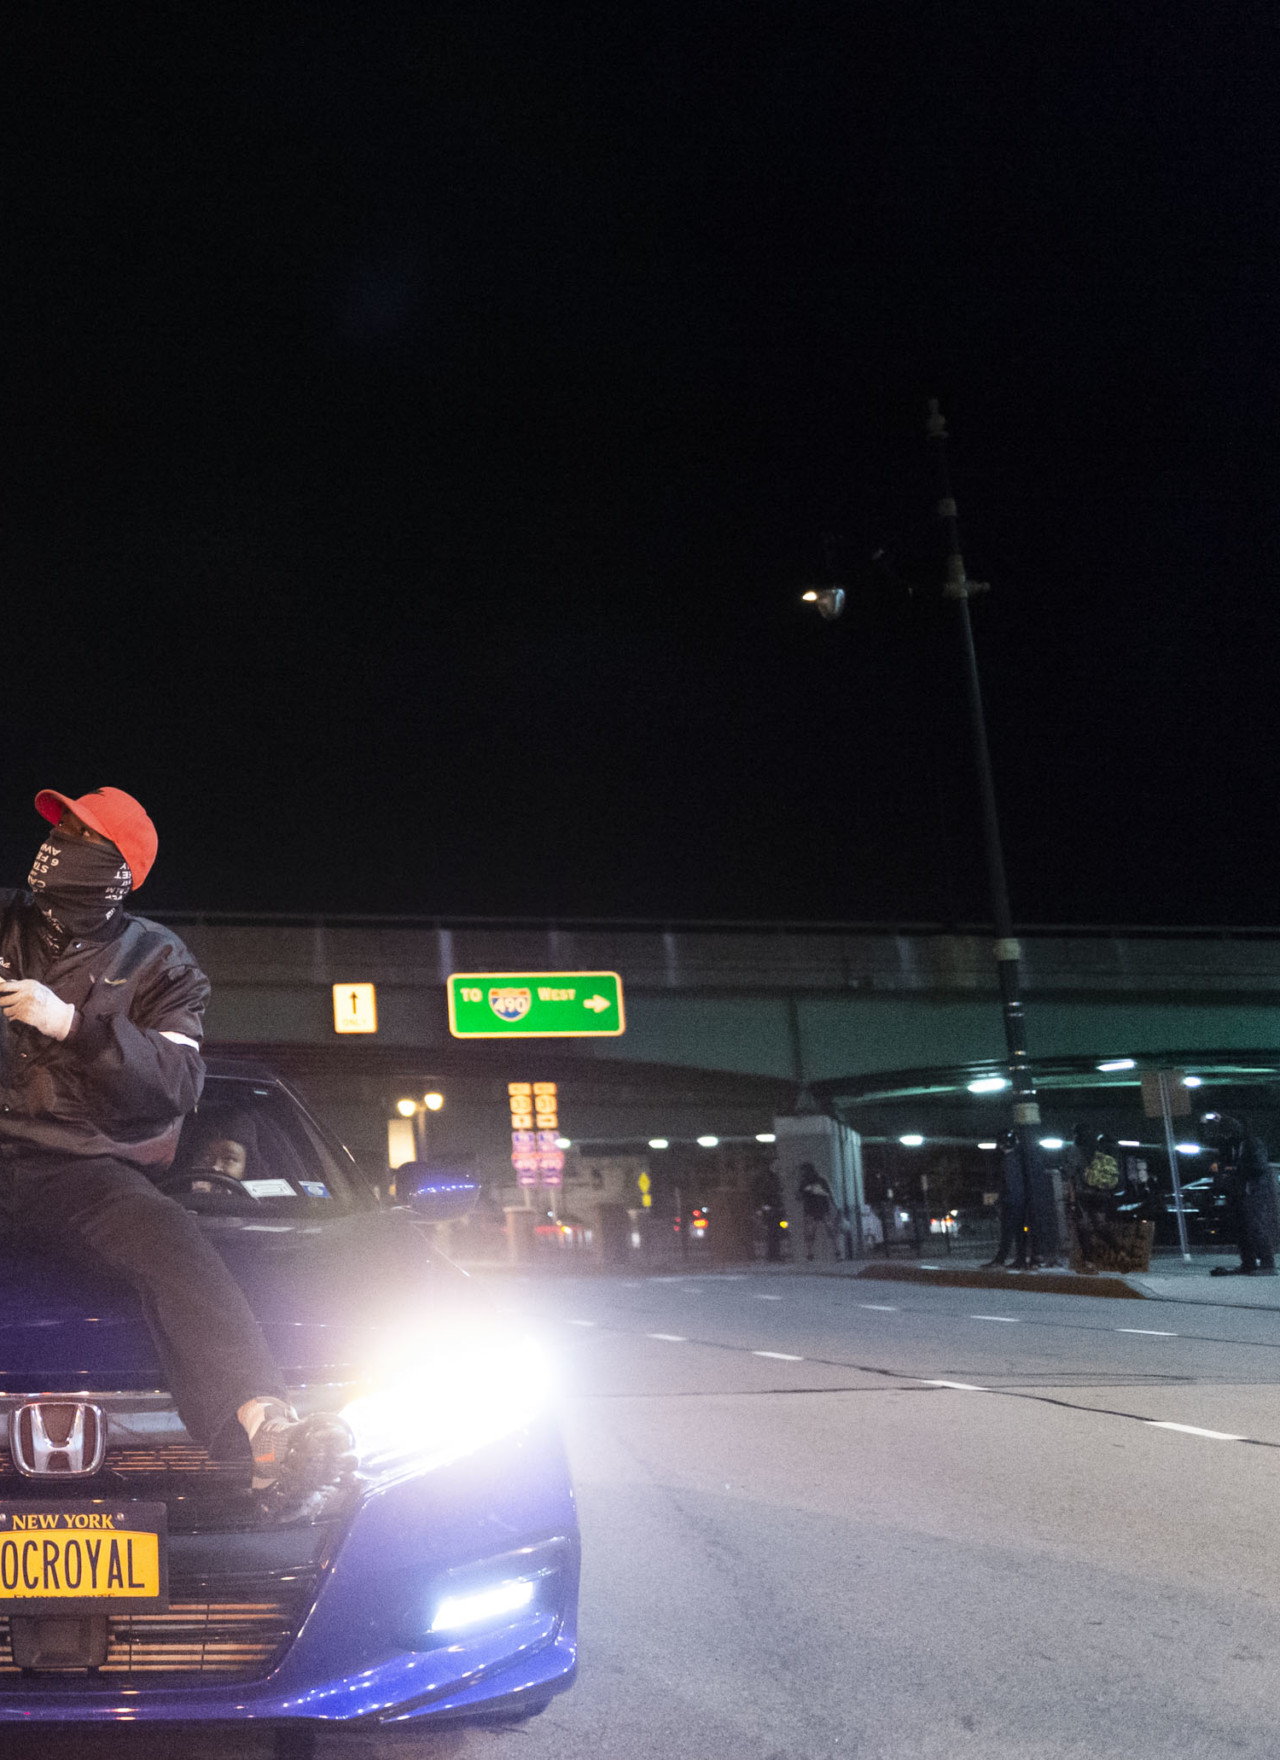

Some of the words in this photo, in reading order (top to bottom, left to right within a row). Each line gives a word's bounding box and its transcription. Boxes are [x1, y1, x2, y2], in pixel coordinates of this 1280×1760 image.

[460, 987, 483, 1003] TO
[493, 997, 526, 1014] 490
[537, 987, 576, 1001] WEST
[12, 1514, 59, 1531] NEW
[63, 1513, 115, 1530] YORK
